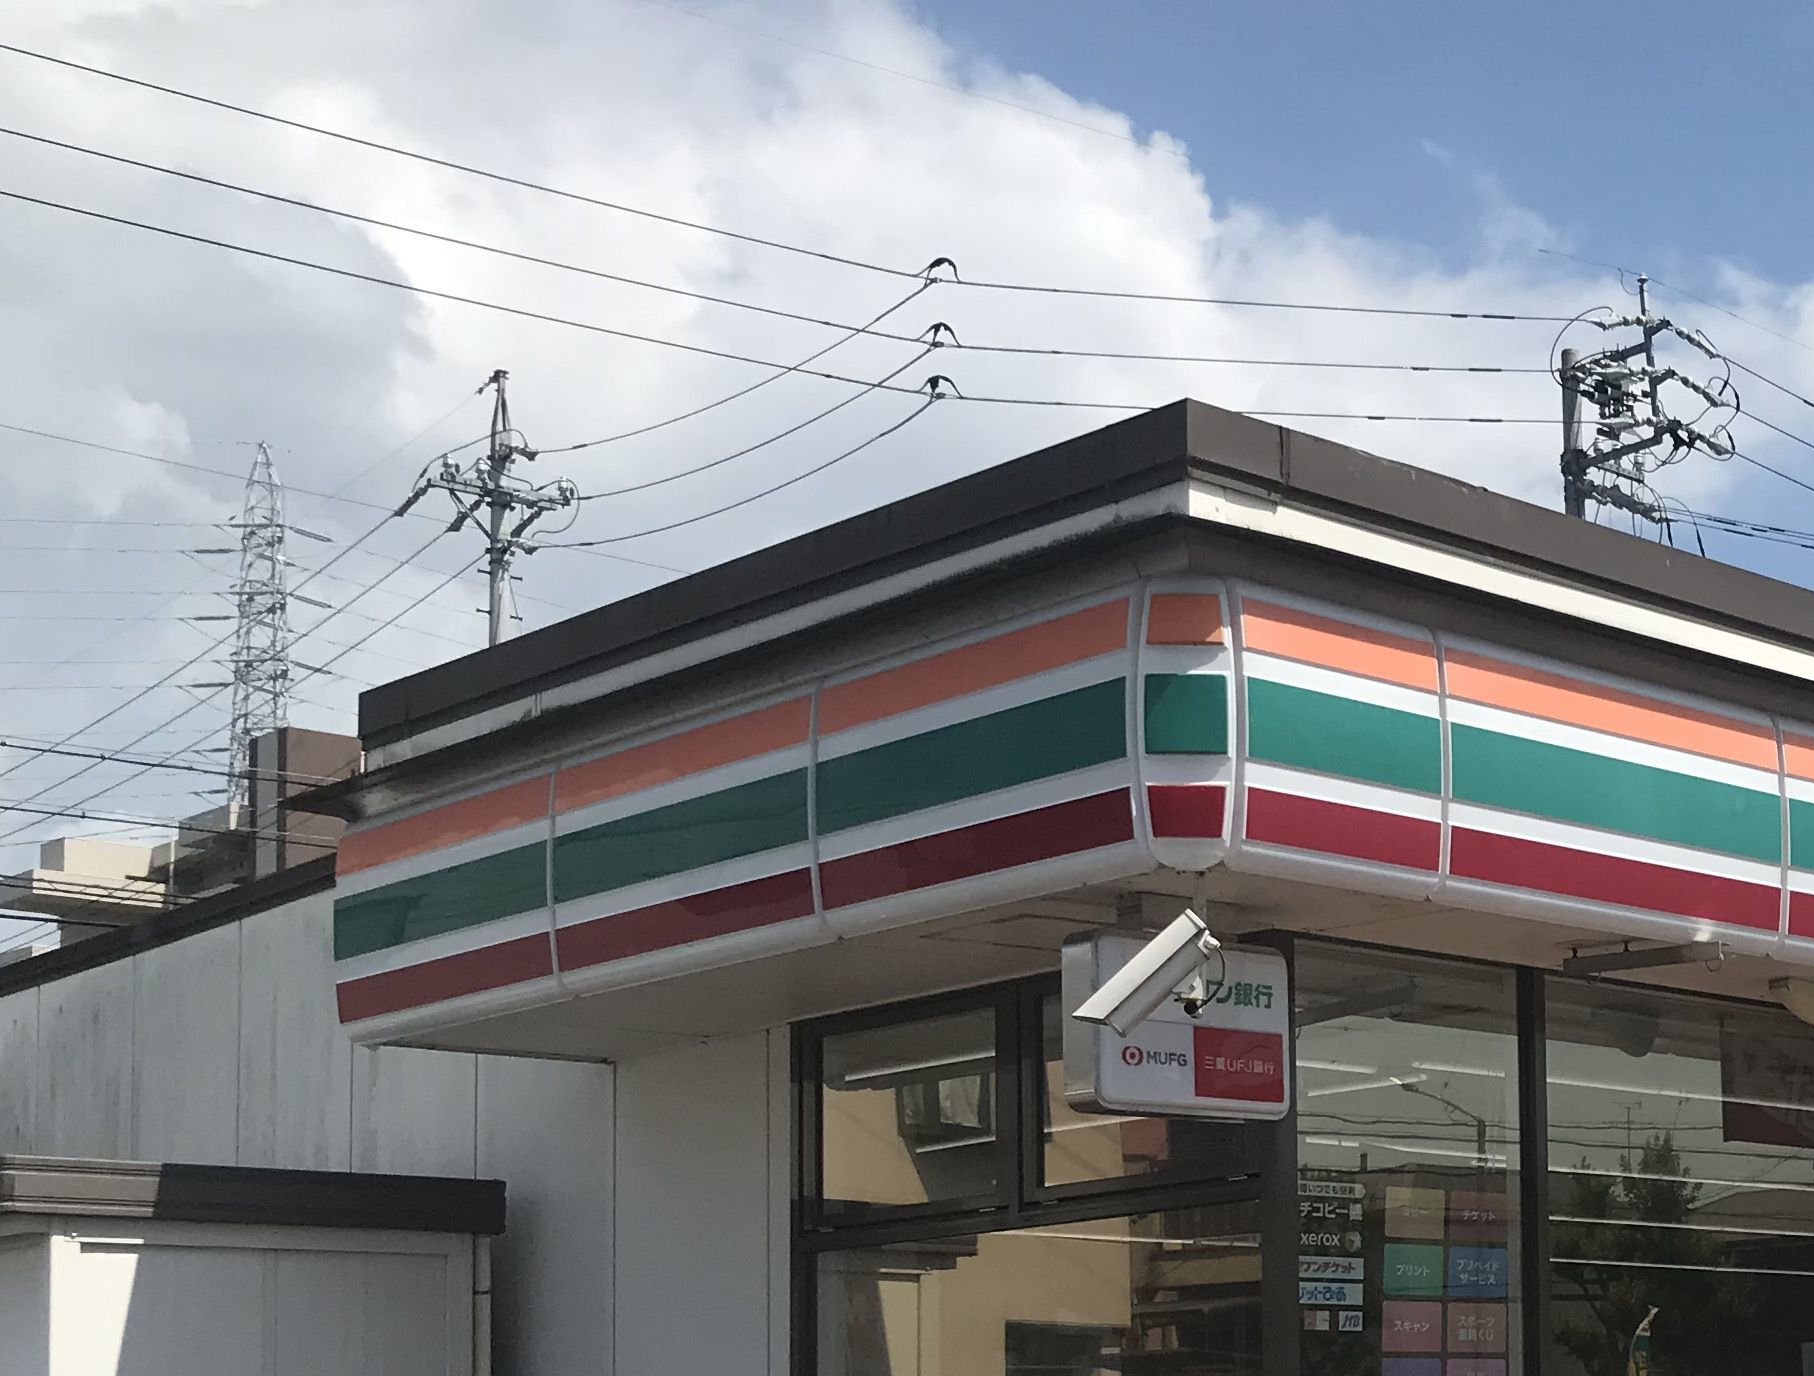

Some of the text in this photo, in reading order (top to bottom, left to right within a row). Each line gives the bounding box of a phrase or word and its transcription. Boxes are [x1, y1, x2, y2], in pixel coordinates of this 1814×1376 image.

[1146, 1050, 1188, 1067] MUFG
[1300, 1232, 1341, 1247] xerox
[1395, 1263, 1431, 1277] プリント
[1459, 1272, 1496, 1286] サービス
[1393, 1319, 1430, 1332] スキャン
